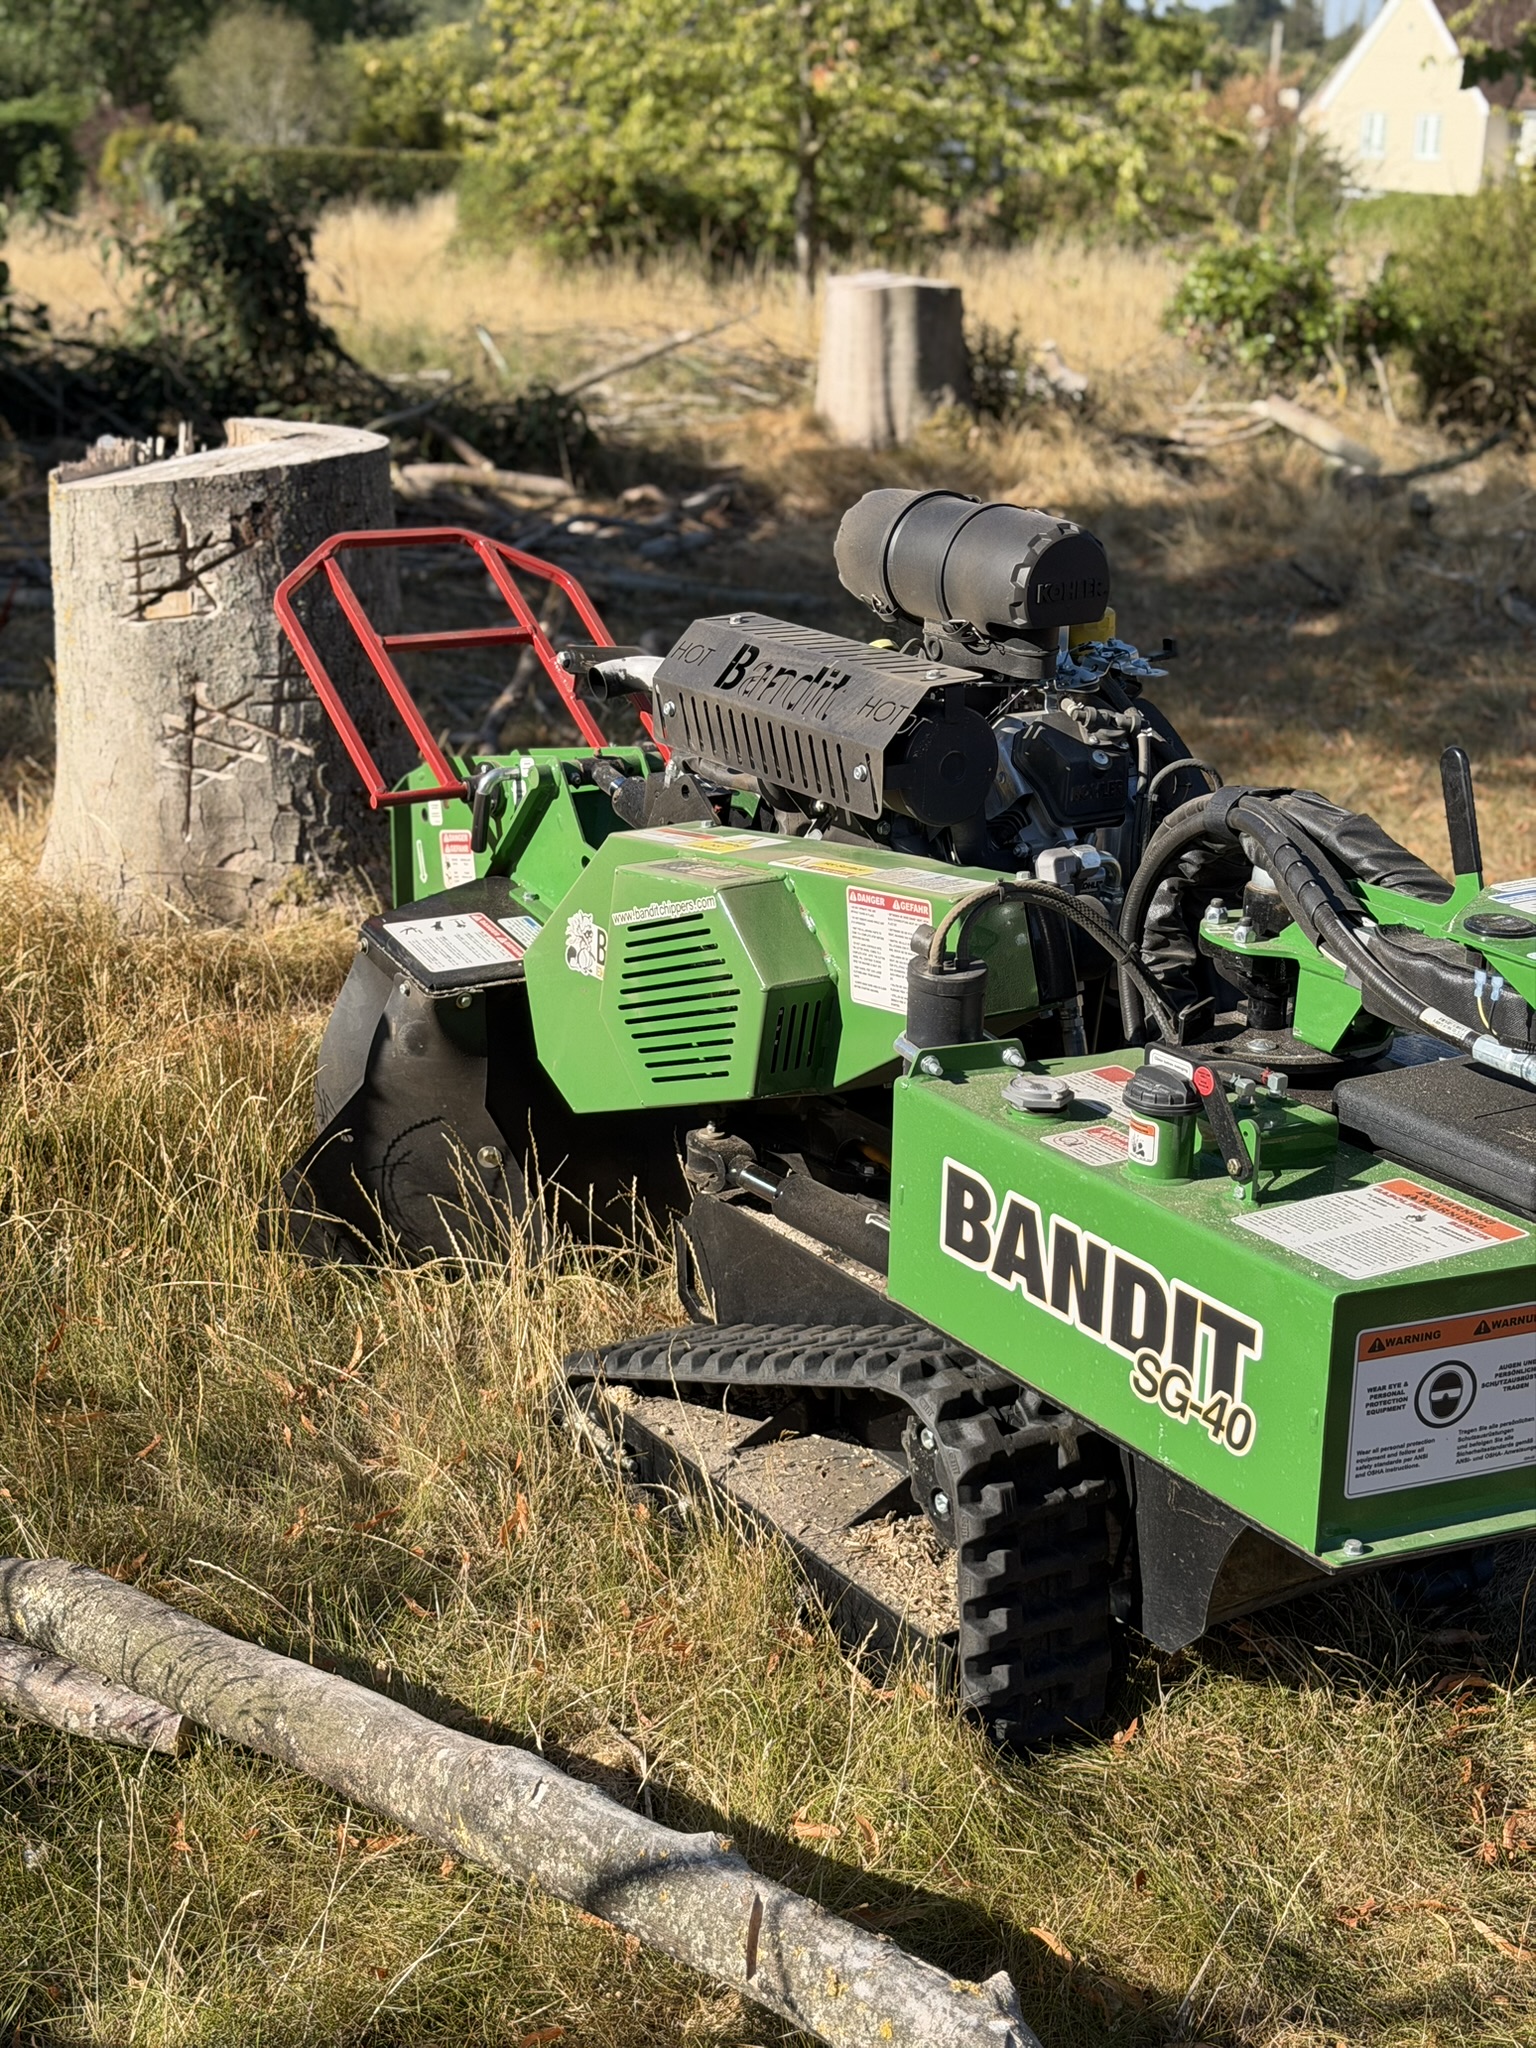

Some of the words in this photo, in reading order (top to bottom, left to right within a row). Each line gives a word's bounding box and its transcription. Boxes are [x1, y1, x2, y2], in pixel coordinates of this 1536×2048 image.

[670, 640, 716, 667] HOT
[713, 643, 853, 722] Bandit
[856, 695, 911, 727] HOT
[856, 892, 886, 907] DANGER
[612, 896, 716, 924] www.banditchippers.com
[900, 901, 929, 915] GEFAHR
[943, 1162, 1258, 1405] BANDIT
[1491, 1313, 1536, 1330] WARNU
[1385, 1330, 1442, 1348] WARNING
[1367, 1385, 1387, 1394] WEAR
[1388, 1381, 1402, 1390] EYE
[1369, 1389, 1406, 1400] PERSONAL
[1502, 1382, 1530, 1392] TRAGEN
[1132, 1351, 1252, 1451] SG-40
[1365, 1396, 1409, 1409] PROTECTION
[1366, 1403, 1406, 1416] EQUIPMENT
[1356, 1448, 1372, 1456] Wear
[1380, 1442, 1405, 1453] personal
[1406, 1437, 1436, 1448] protection
[1356, 1455, 1386, 1464] equipment
[1398, 1448, 1417, 1456] follow
[1373, 1457, 1402, 1468] standards
[1403, 1456, 1413, 1464] per
[1413, 1453, 1429, 1461] ANSI
[1366, 1468, 1384, 1476] OSHA
